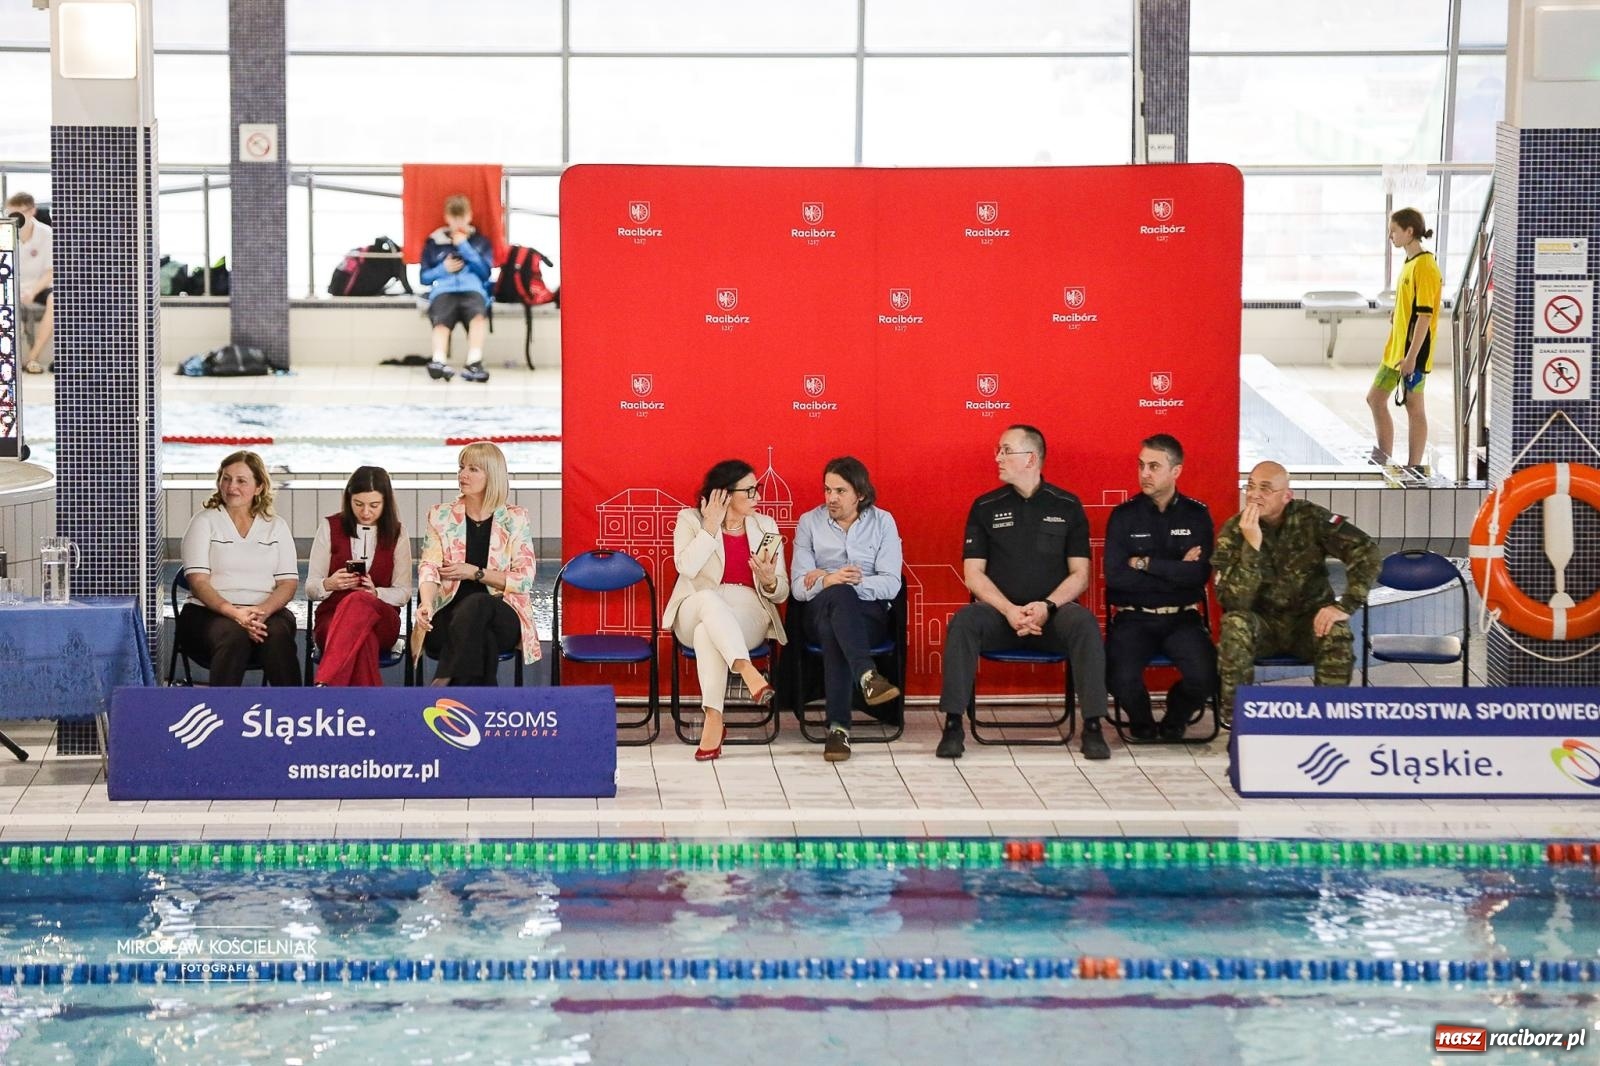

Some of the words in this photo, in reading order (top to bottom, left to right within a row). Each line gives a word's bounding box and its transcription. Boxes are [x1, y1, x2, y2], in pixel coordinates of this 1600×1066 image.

[618, 227, 662, 237] Racibórz
[792, 228, 836, 238] Racibórz
[966, 227, 1010, 237] Racibórz
[1141, 224, 1185, 234] Racibórz
[706, 314, 750, 324] Racibórz
[879, 314, 923, 324] Racibórz
[1053, 312, 1097, 322] Racibórz
[621, 400, 665, 410] Racibórz
[793, 400, 837, 410] Racibórz
[966, 400, 1010, 410] Racibórz
[1140, 398, 1184, 408] Racibórz
[1244, 701, 1322, 719] SZKOŁA
[1326, 702, 1471, 720] MISTRZOSTWA
[1476, 702, 1600, 720] SPORTOWEG
[241, 703, 376, 745] Śląskie.
[485, 711, 558, 728] ZSOMS
[484, 728, 559, 738] RACIBÓRZ
[1370, 743, 1503, 784] Śląskie.
[288, 758, 440, 783] smsraciborz.pl
